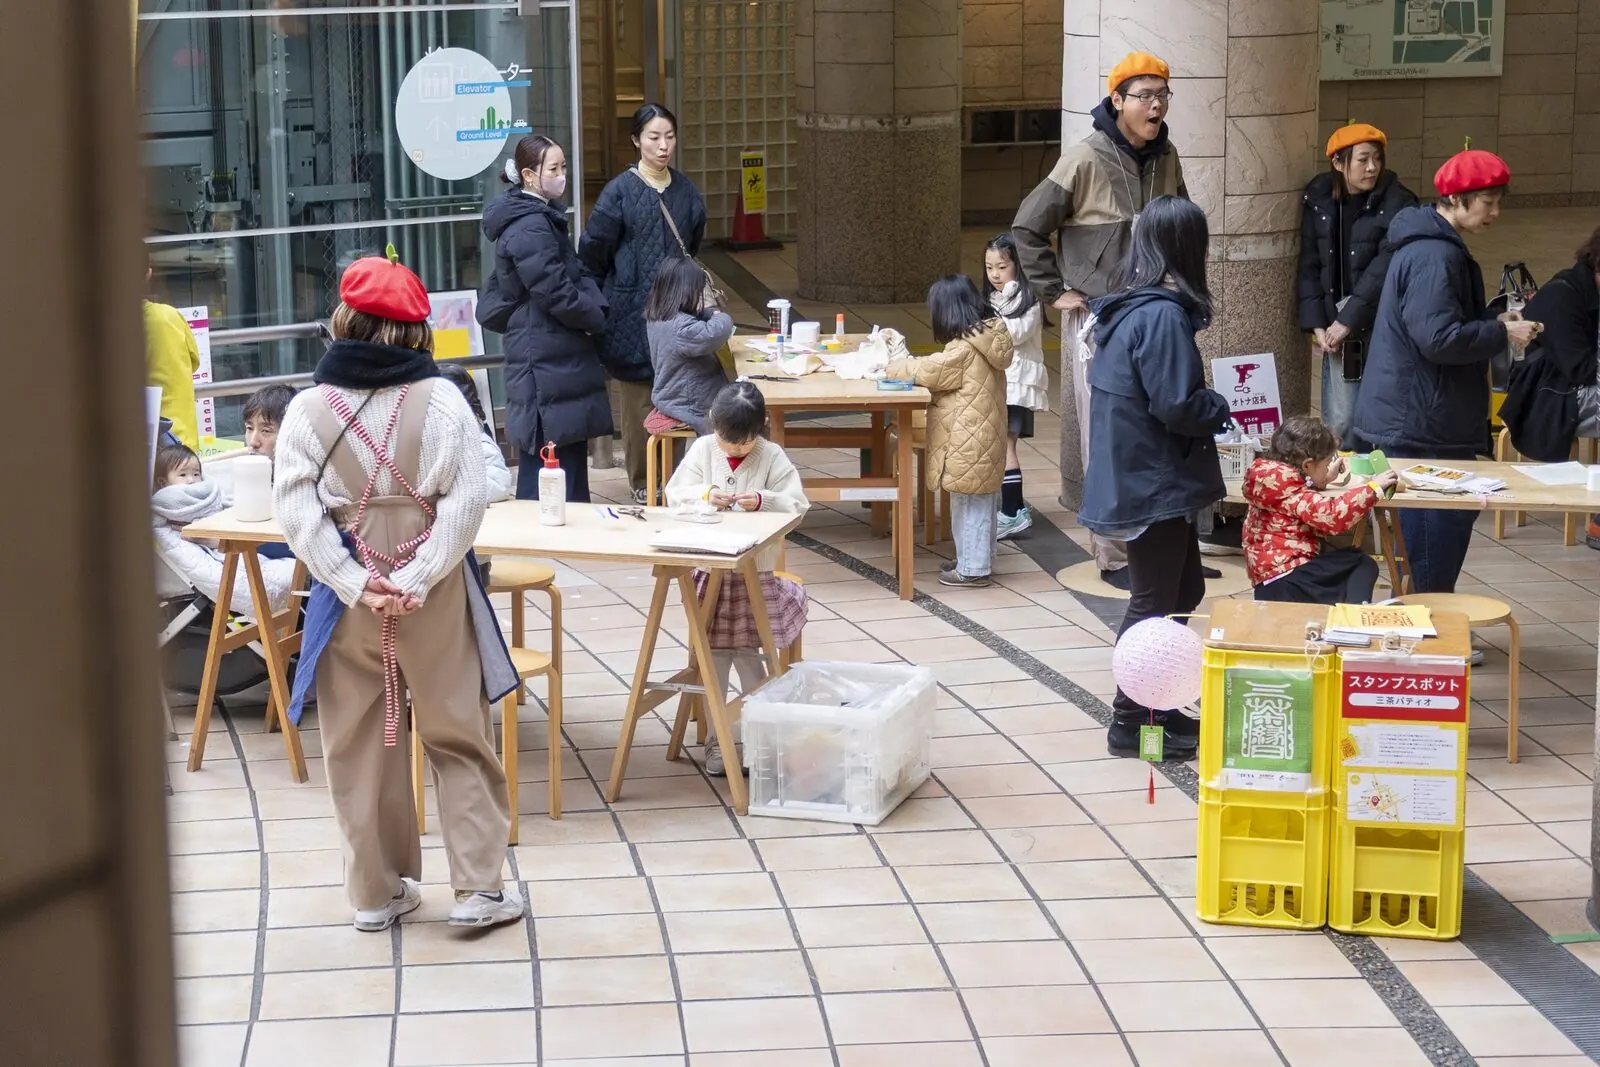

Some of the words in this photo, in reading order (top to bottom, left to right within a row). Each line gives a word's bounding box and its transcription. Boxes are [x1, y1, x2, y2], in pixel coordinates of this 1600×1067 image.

[457, 84, 492, 94] Elevator
[460, 131, 484, 140] Ground
[485, 131, 502, 139] Level
[1232, 395, 1268, 407] オトナ店長
[1349, 675, 1460, 692] スタンプスポット
[1376, 696, 1432, 707] 三茶パティオ
